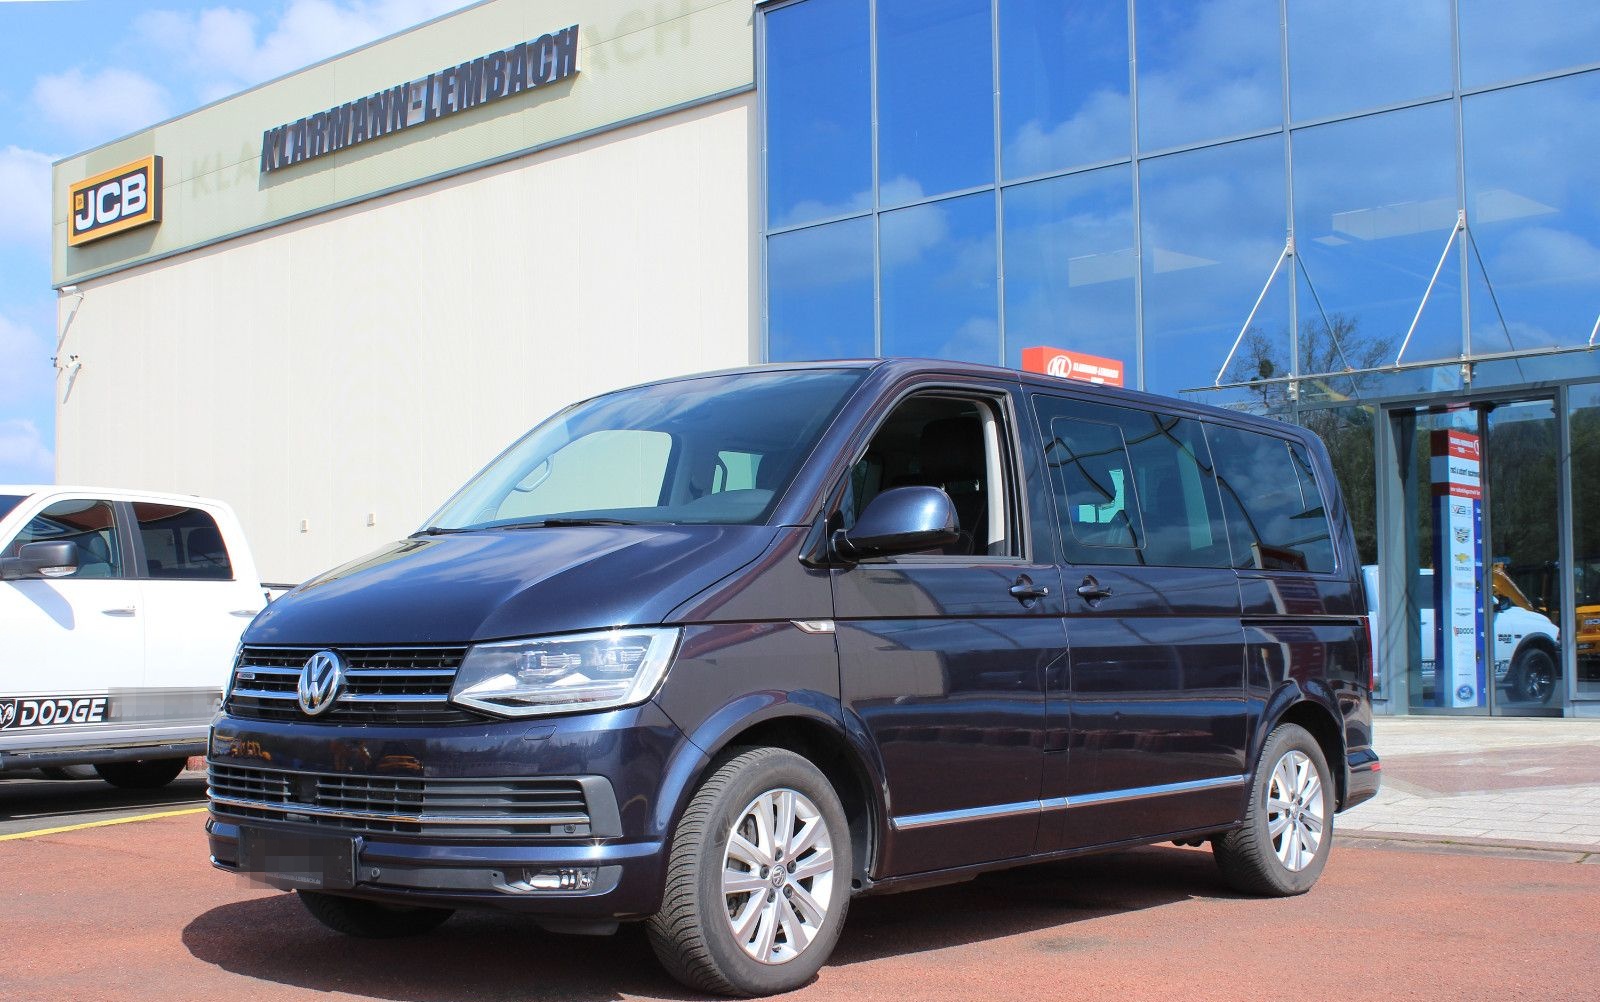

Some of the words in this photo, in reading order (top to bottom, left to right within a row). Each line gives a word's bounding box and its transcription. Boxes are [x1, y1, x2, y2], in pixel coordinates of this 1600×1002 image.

[261, 24, 579, 172] KLARMANN-LEMBACH
[75, 173, 147, 231] JCB
[20, 699, 107, 726] DODGE
